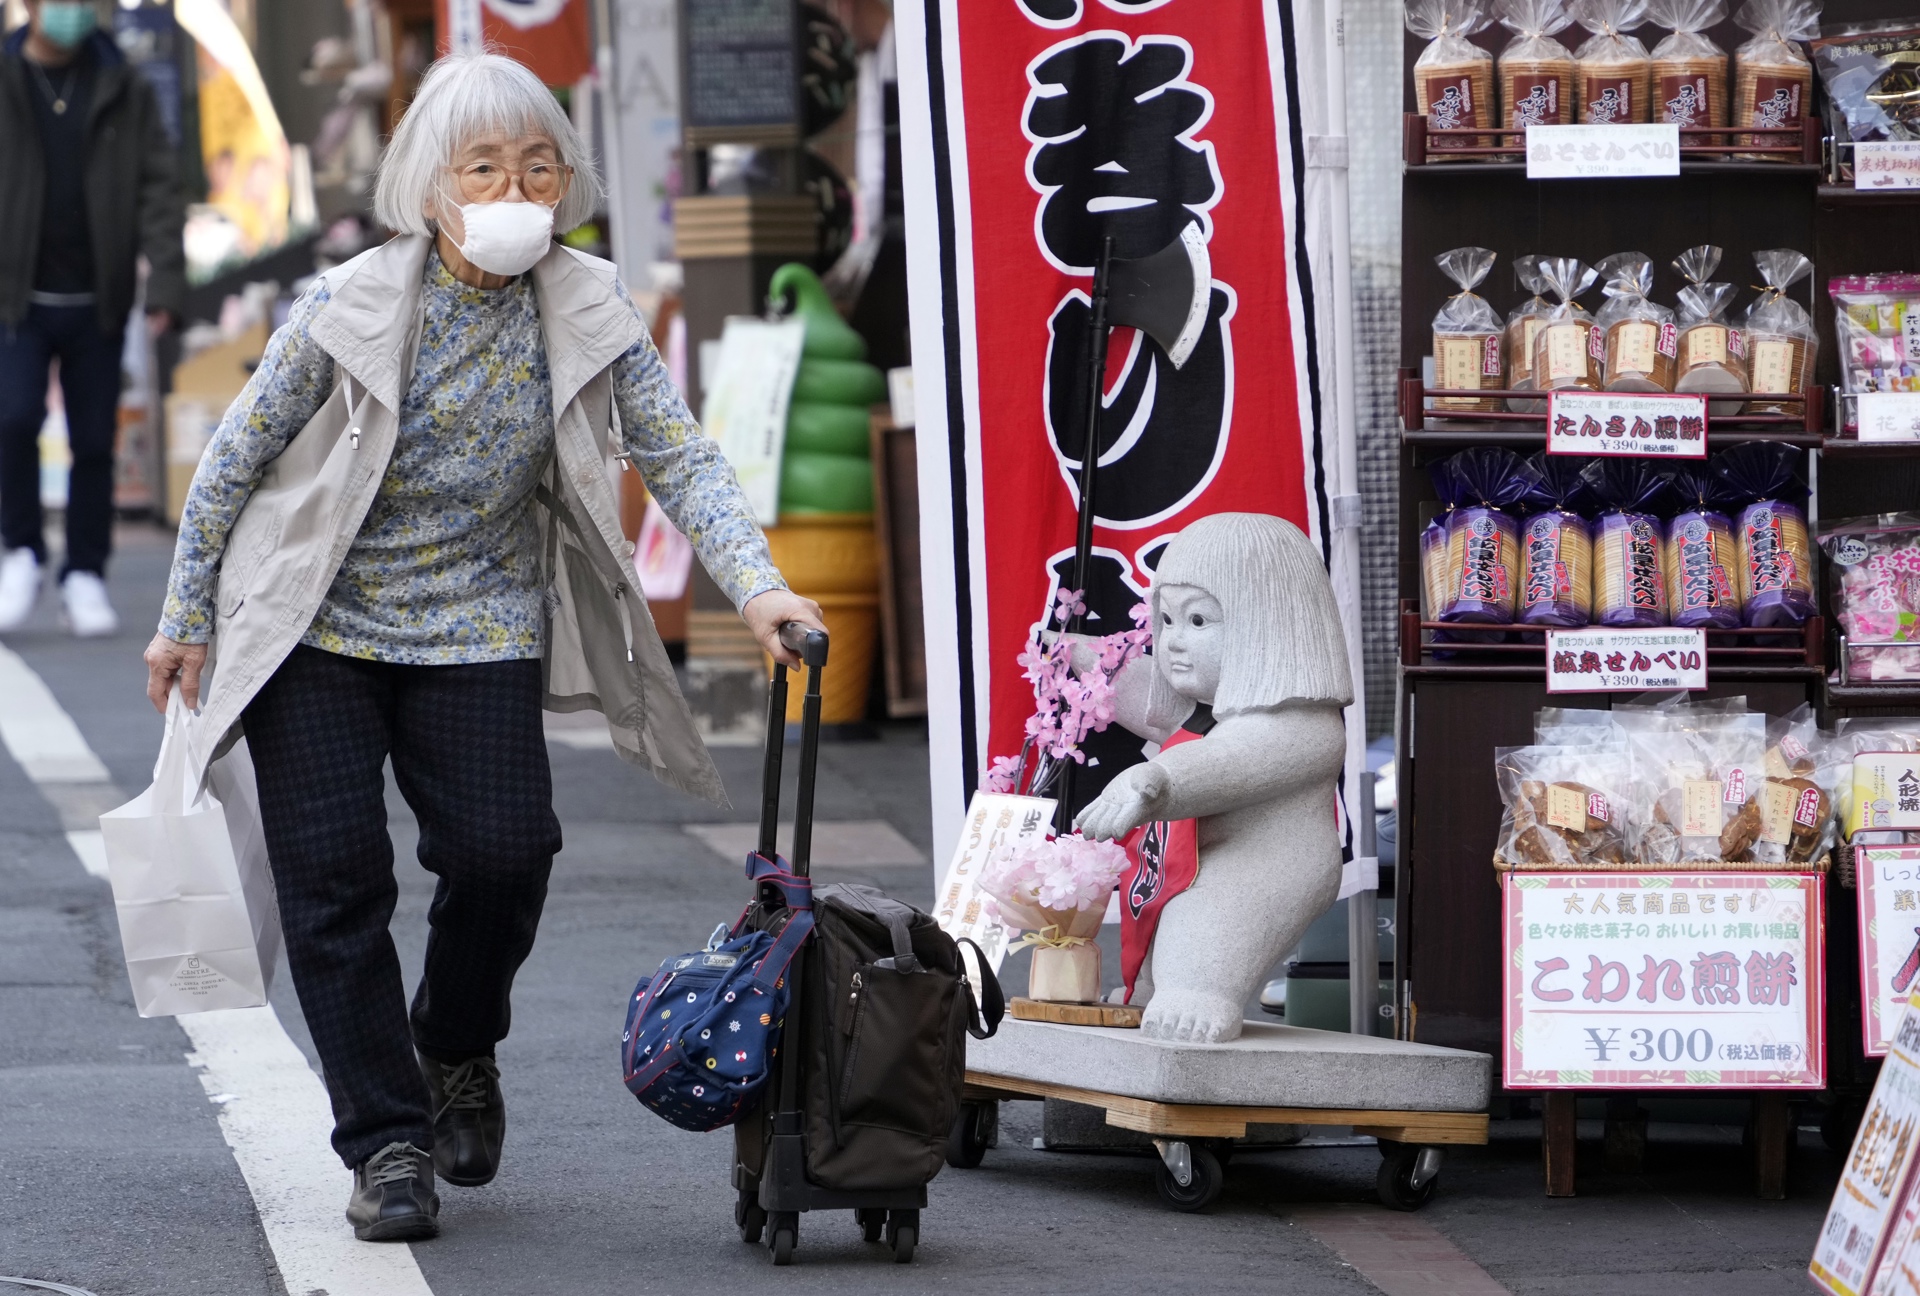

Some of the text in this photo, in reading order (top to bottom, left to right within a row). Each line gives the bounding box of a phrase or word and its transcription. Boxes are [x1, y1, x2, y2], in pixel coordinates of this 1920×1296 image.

[1531, 141, 1675, 162] みそせんべい
[1575, 164, 1610, 174] ¥390
[1859, 155, 1920, 172] 炭焼珈琲
[1554, 414, 1704, 441] たんさん煎餅
[1600, 440, 1638, 450] ¥390
[1892, 547, 1920, 572] 桜
[1868, 554, 1896, 612] ふぁふぁ
[1557, 637, 1604, 647] 昔なつかしい味
[1553, 650, 1701, 673] 鉱泉せんべい
[1599, 675, 1639, 686] ¥390
[1898, 768, 1920, 812] 人形焼
[1563, 892, 1758, 915] 大人気商品です!
[1528, 922, 1800, 940] 色々な焼き菓子の おいしい お買い得品
[181, 968, 210, 976] CENTRE
[1531, 950, 1798, 1006] こわれ煎餅
[1583, 1028, 1802, 1062] ¥300 （税込価格）
